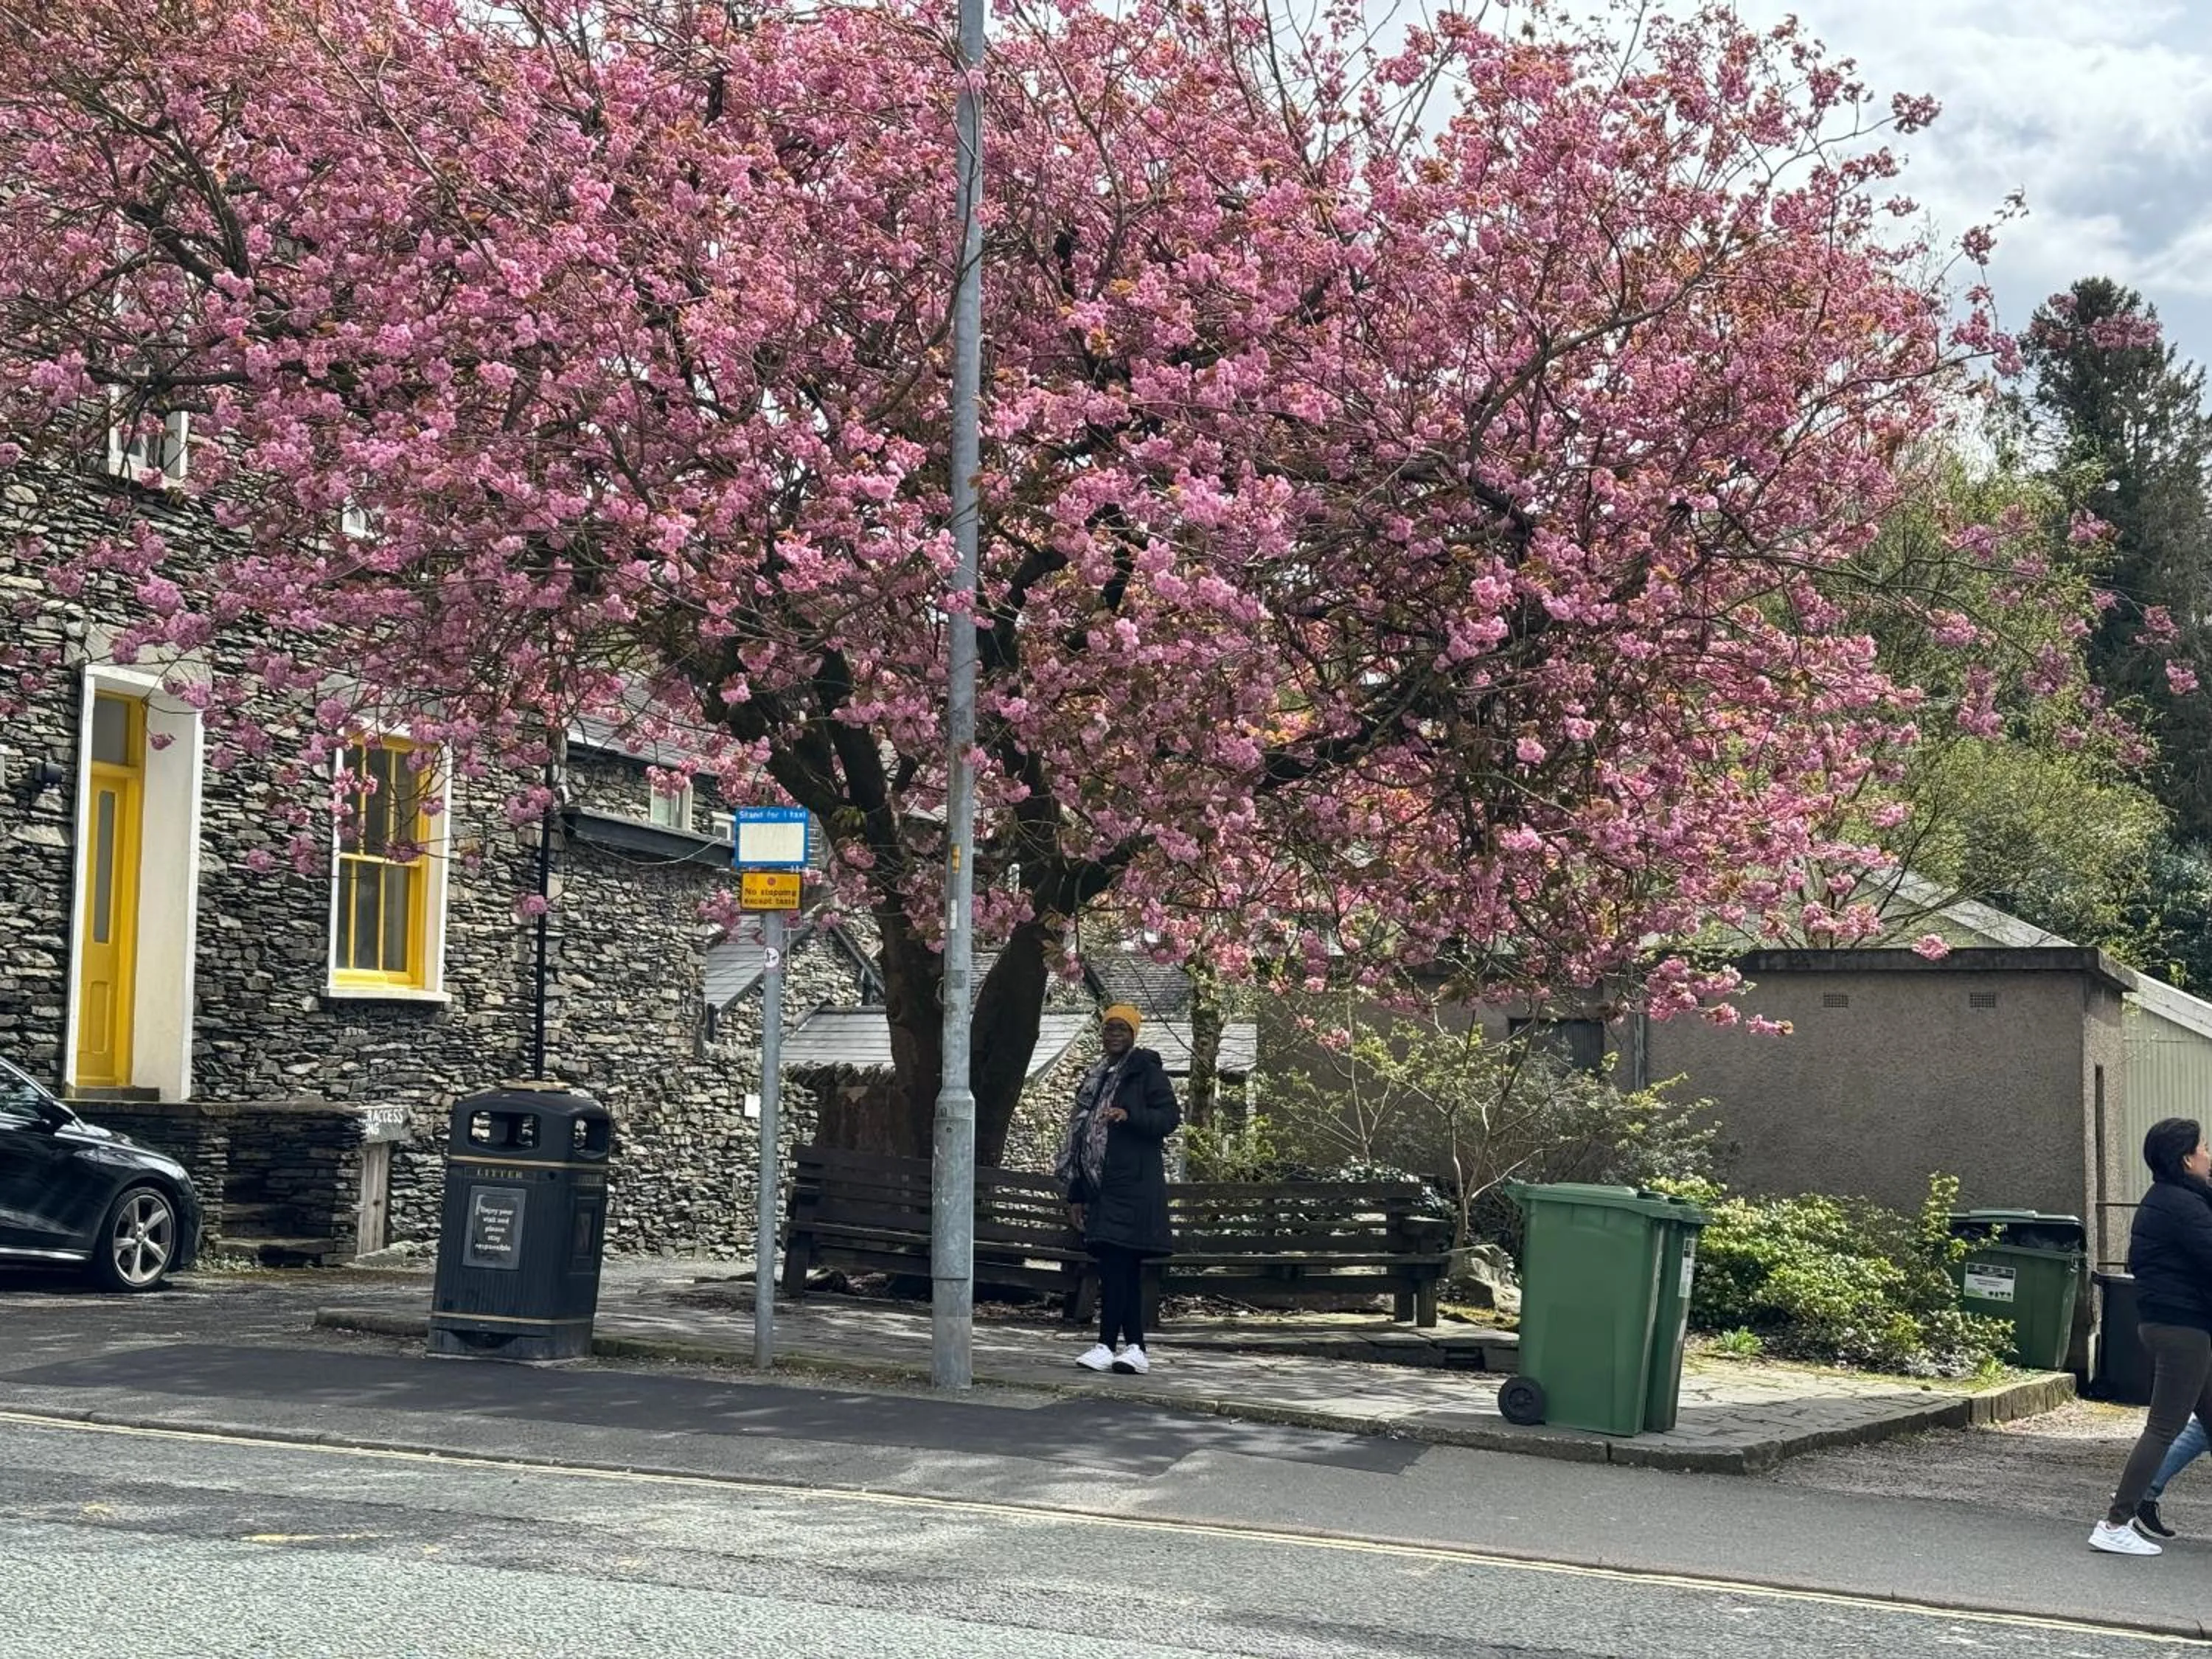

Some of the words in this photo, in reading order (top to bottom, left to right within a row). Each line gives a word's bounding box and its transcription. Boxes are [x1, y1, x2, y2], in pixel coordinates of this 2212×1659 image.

[739, 810, 763, 819] Stand
[767, 811, 779, 819] for
[790, 811, 807, 819] taxi
[761, 888, 797, 897] stopping
[745, 897, 772, 905] except
[373, 1108, 403, 1124] ACCESS
[477, 1168, 523, 1179] LITTER
